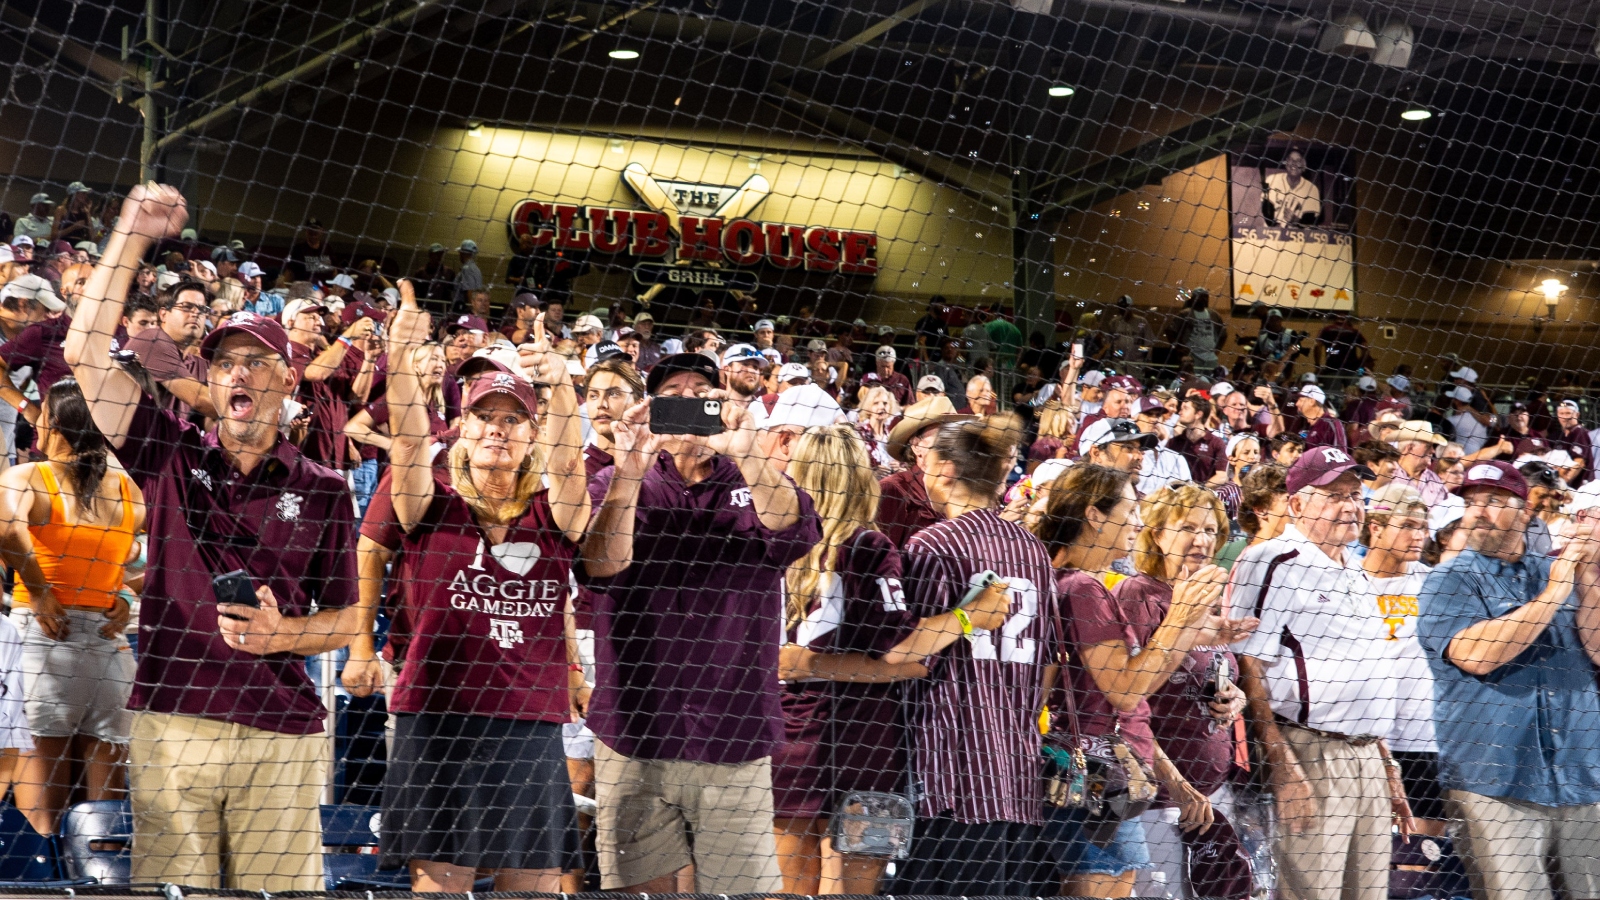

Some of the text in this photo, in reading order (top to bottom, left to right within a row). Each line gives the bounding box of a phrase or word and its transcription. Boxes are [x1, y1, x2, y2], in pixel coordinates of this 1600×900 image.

[674, 188, 719, 207] THE
[1238, 227, 1353, 246] '56 '57 '58 '59 '60
[667, 269, 725, 286] GRILL
[446, 569, 560, 601] AGGIE
[450, 593, 556, 618] GAMEDAY
